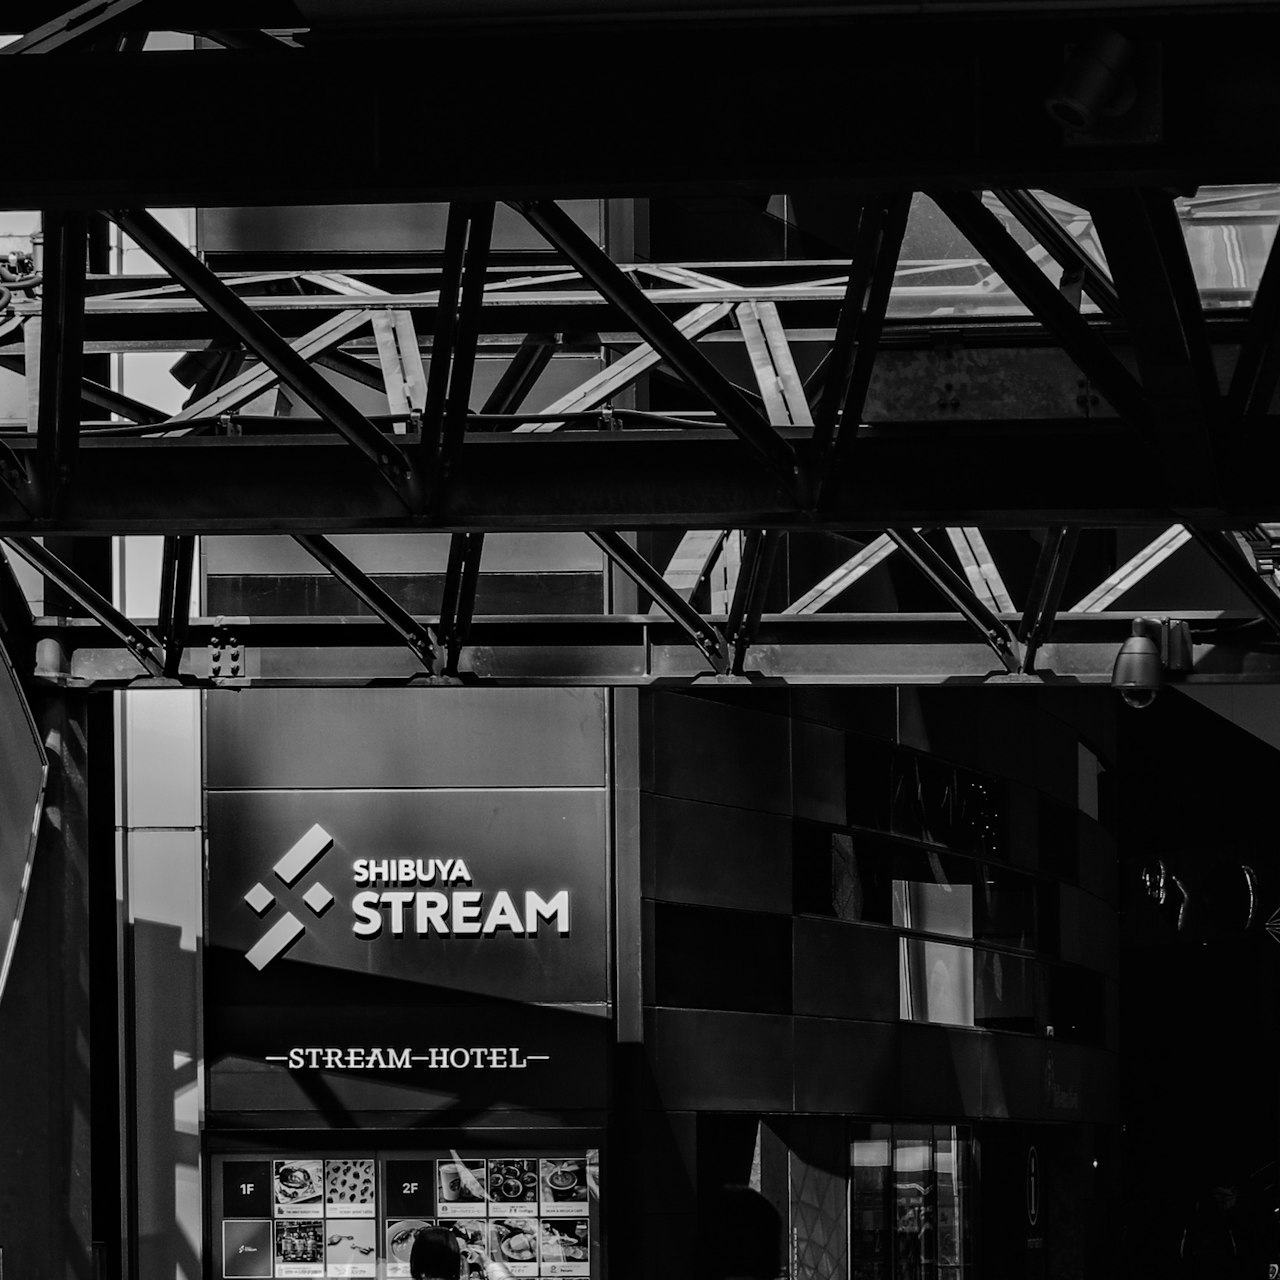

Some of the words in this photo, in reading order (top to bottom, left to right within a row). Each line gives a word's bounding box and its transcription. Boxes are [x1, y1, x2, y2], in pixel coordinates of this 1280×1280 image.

[352, 858, 472, 883] SHIBUYA
[351, 890, 570, 936] STREAM
[288, 1047, 413, 1070] STREAM
[427, 1047, 527, 1069] HOTEL
[239, 1183, 256, 1196] 1F
[402, 1182, 419, 1195] 2F
